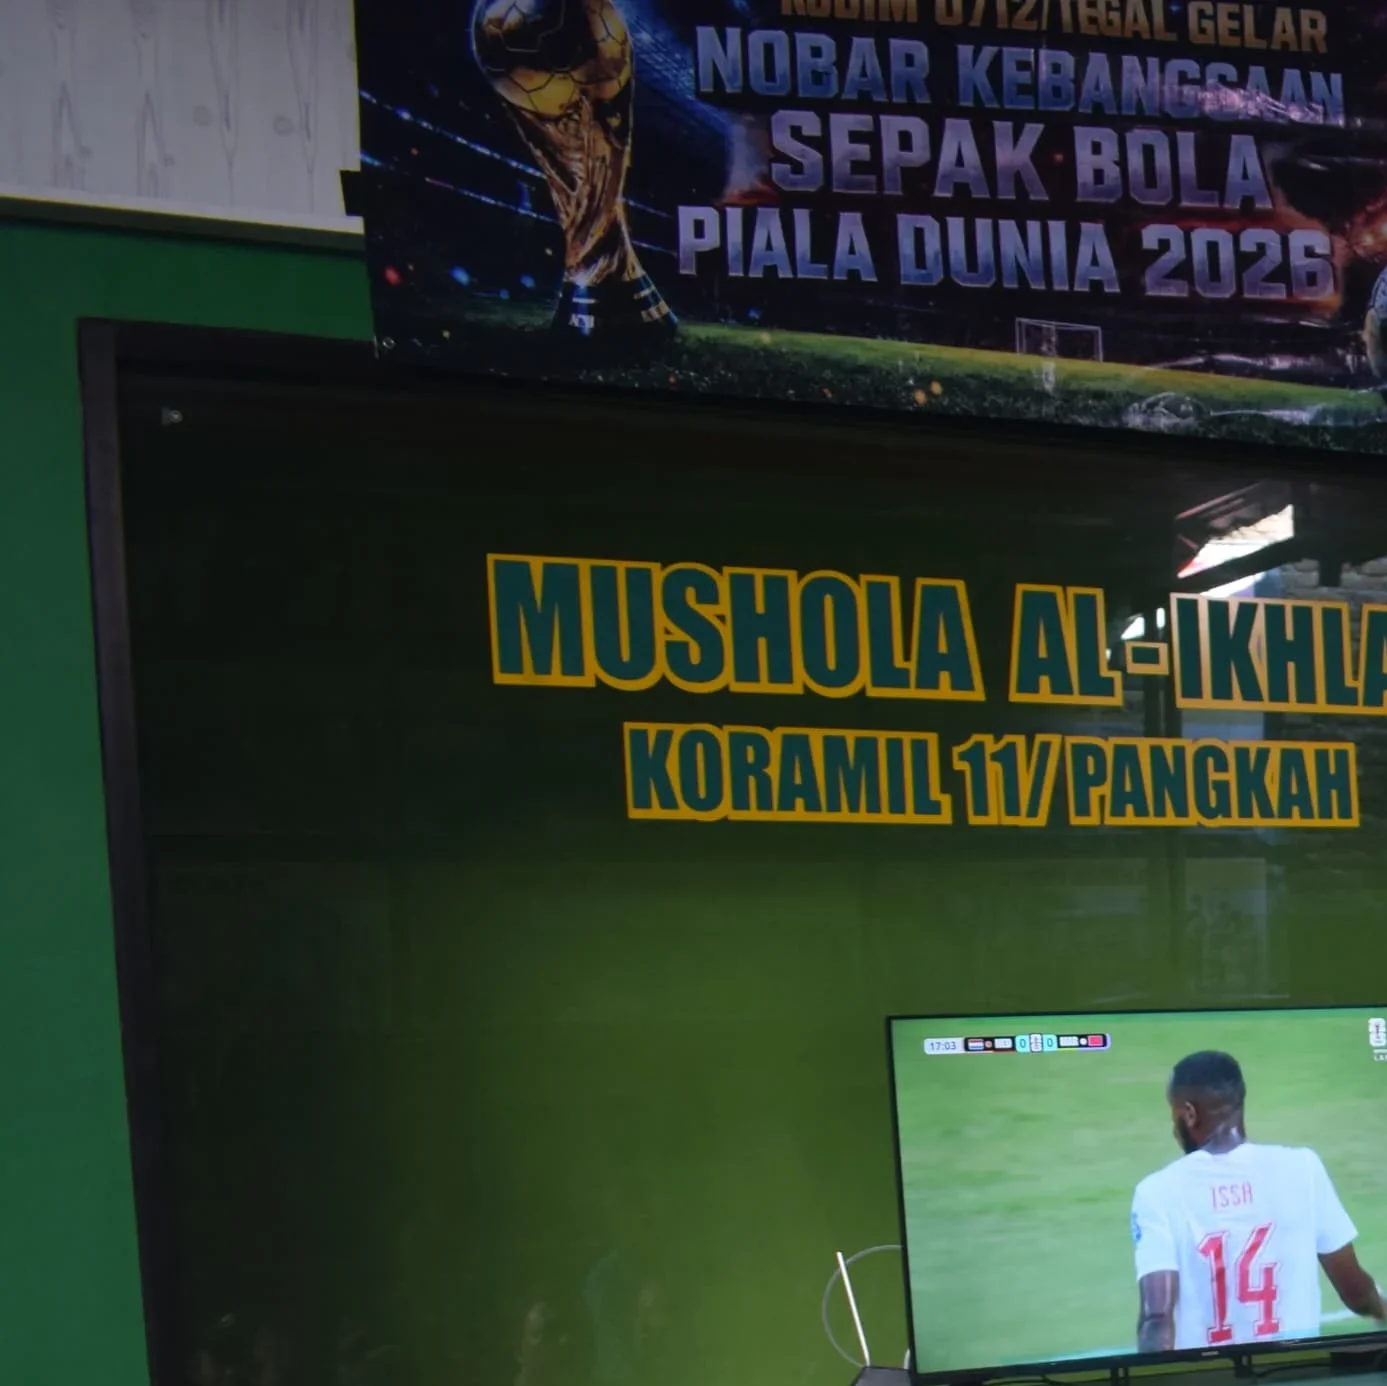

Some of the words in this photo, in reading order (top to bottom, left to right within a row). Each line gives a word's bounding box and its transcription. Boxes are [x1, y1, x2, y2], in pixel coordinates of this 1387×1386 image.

[692, 25, 931, 106] NOBAR
[956, 44, 1346, 128] KEBANGSAAN
[1188, 1, 1329, 53] GELAR
[769, 109, 1048, 202] SEPAK
[1075, 127, 1273, 210] BOLA
[676, 206, 878, 285] PIALA
[899, 215, 1121, 294] DUNIA
[1140, 223, 1338, 302] 2026
[486, 552, 985, 703] MUSHOLA
[623, 721, 953, 825] KORAMIL
[929, 1040, 957, 1051] 17:03
[1212, 1182, 1253, 1209] ISSA
[1198, 1222, 1282, 1344] 14
